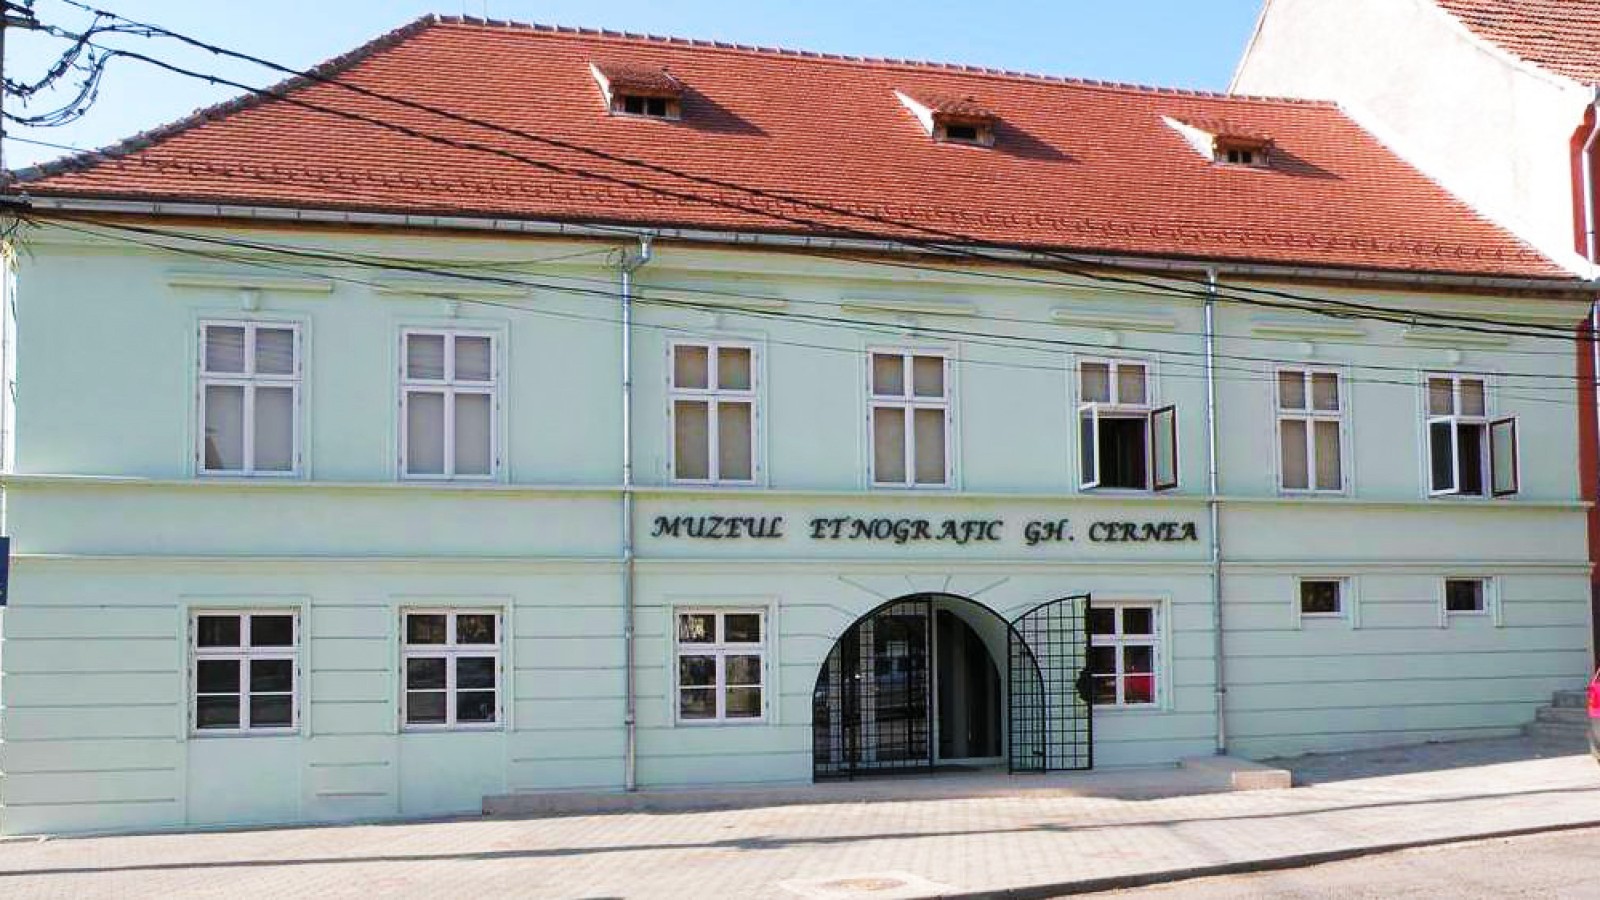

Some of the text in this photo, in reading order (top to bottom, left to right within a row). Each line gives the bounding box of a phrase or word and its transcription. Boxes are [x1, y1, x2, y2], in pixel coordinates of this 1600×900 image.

[652, 516, 1198, 545] MUZEUL ETNOGRAFIC GH. CERNEA
